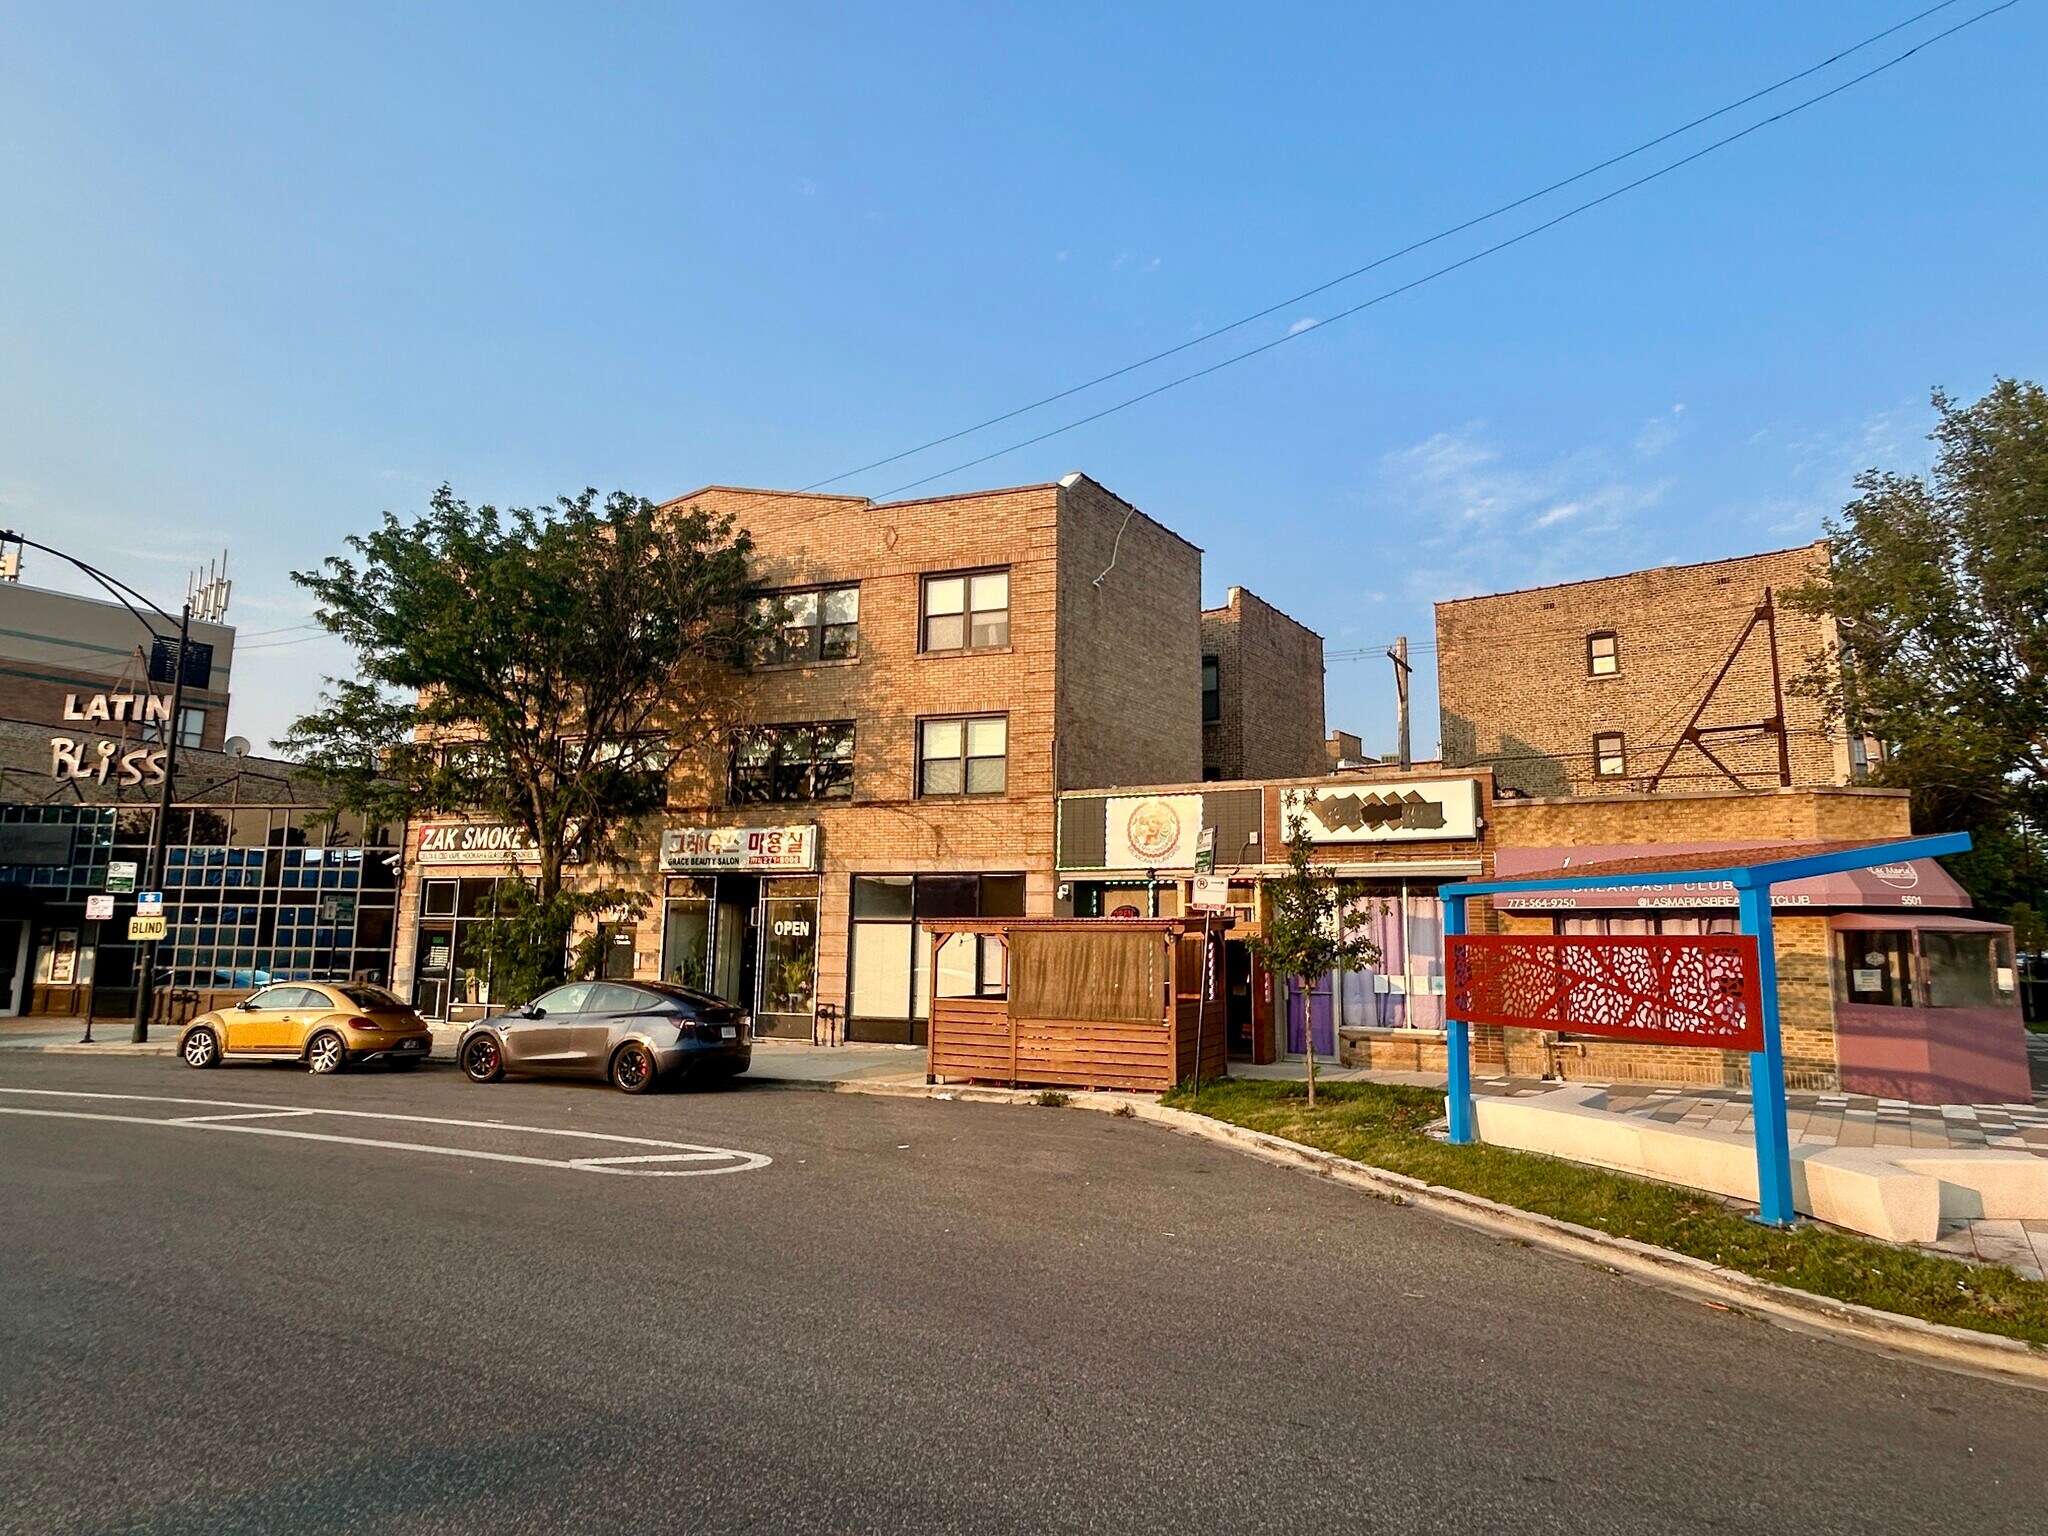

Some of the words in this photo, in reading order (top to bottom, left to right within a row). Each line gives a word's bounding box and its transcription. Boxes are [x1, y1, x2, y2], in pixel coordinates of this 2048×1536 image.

[63, 693, 173, 720] LATIN
[421, 827, 459, 850] ZAK
[461, 826, 524, 850] SMOKE
[748, 832, 803, 855] 미용실
[668, 857, 689, 866] GRACE
[690, 857, 716, 866] BEAUTY
[717, 857, 740, 866] SALON
[1683, 881, 1734, 891] CLUB
[1507, 898, 1577, 908] 773-564-9250
[1901, 895, 1922, 905] 5501
[131, 922, 163, 934] BLIND
[774, 920, 810, 936] OPEN
